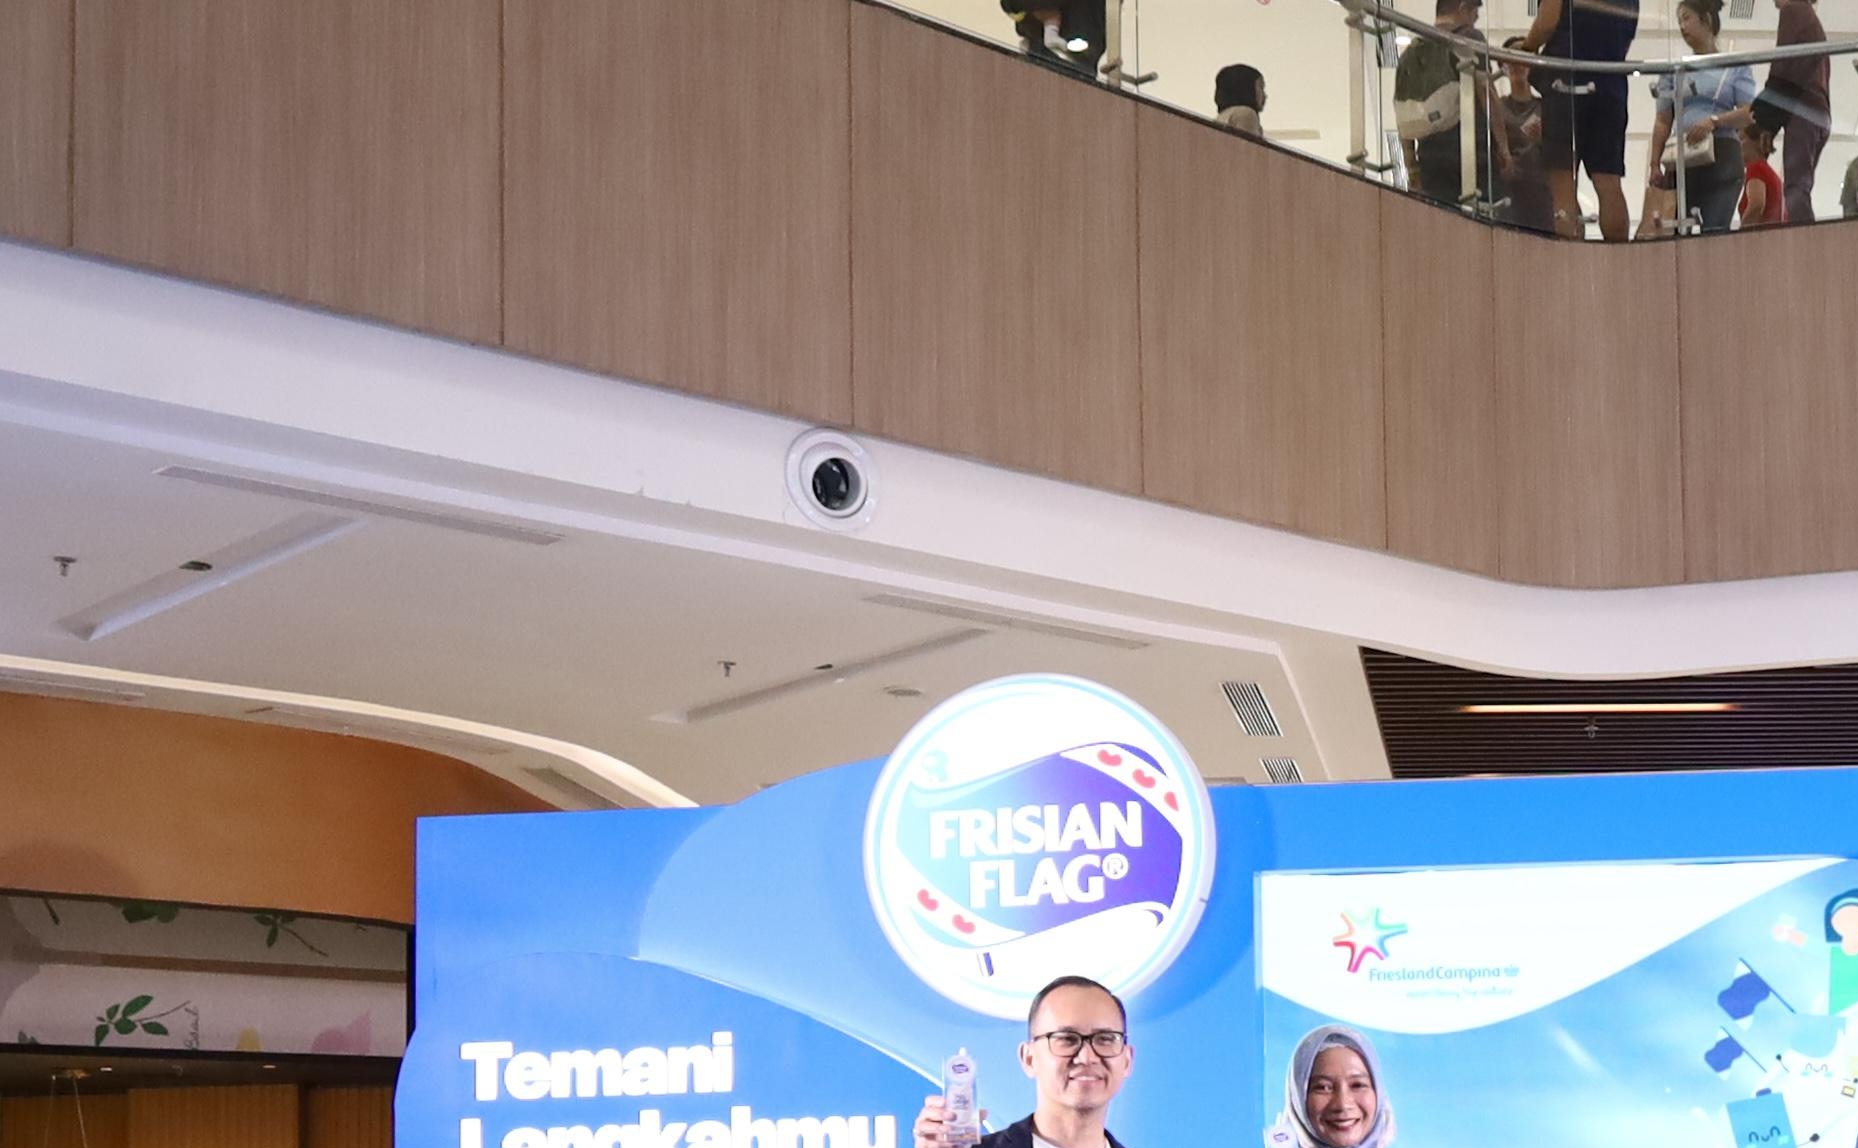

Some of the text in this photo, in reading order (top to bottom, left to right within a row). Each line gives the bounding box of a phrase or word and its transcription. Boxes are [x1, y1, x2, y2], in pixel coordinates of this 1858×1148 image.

[930, 801, 1143, 859] FRISIAN
[1369, 966, 1500, 983] FrieslandCampina
[460, 1031, 733, 1101] Temani
